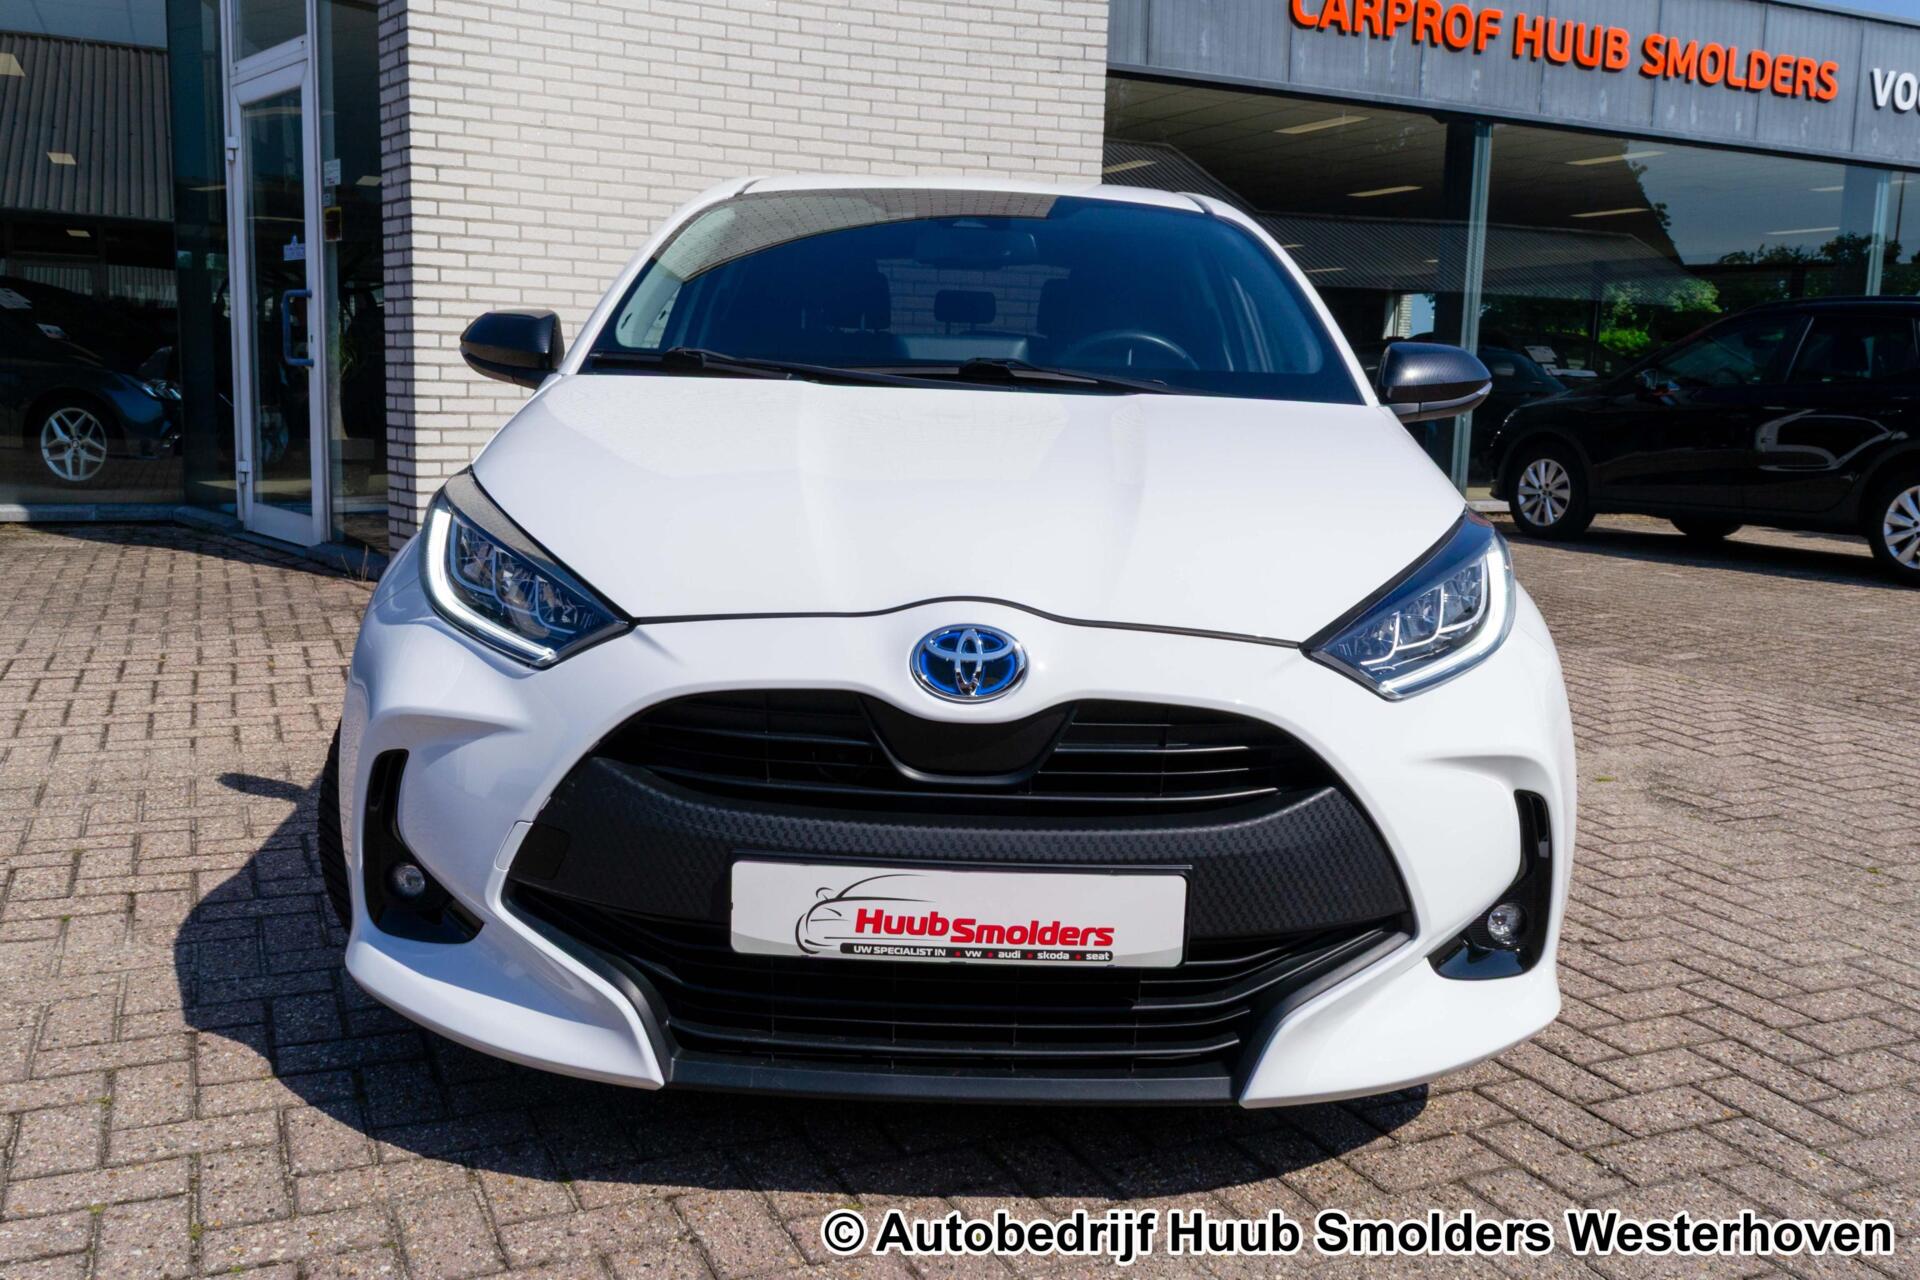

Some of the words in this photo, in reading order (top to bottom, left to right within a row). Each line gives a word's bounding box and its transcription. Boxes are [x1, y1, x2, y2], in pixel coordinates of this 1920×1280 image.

[1292, 0, 1504, 51] CARPROF
[1514, 13, 1630, 70] HUUB
[1641, 33, 1839, 101] SMOLDERS
[1872, 68, 1920, 111] VO
[853, 945, 872, 954] UW
[873, 946, 933, 956] SPECIALIST
[934, 948, 946, 956] IN
[998, 950, 1021, 959] audi
[1037, 951, 1069, 960] skoda
[1086, 952, 1110, 961] seat
